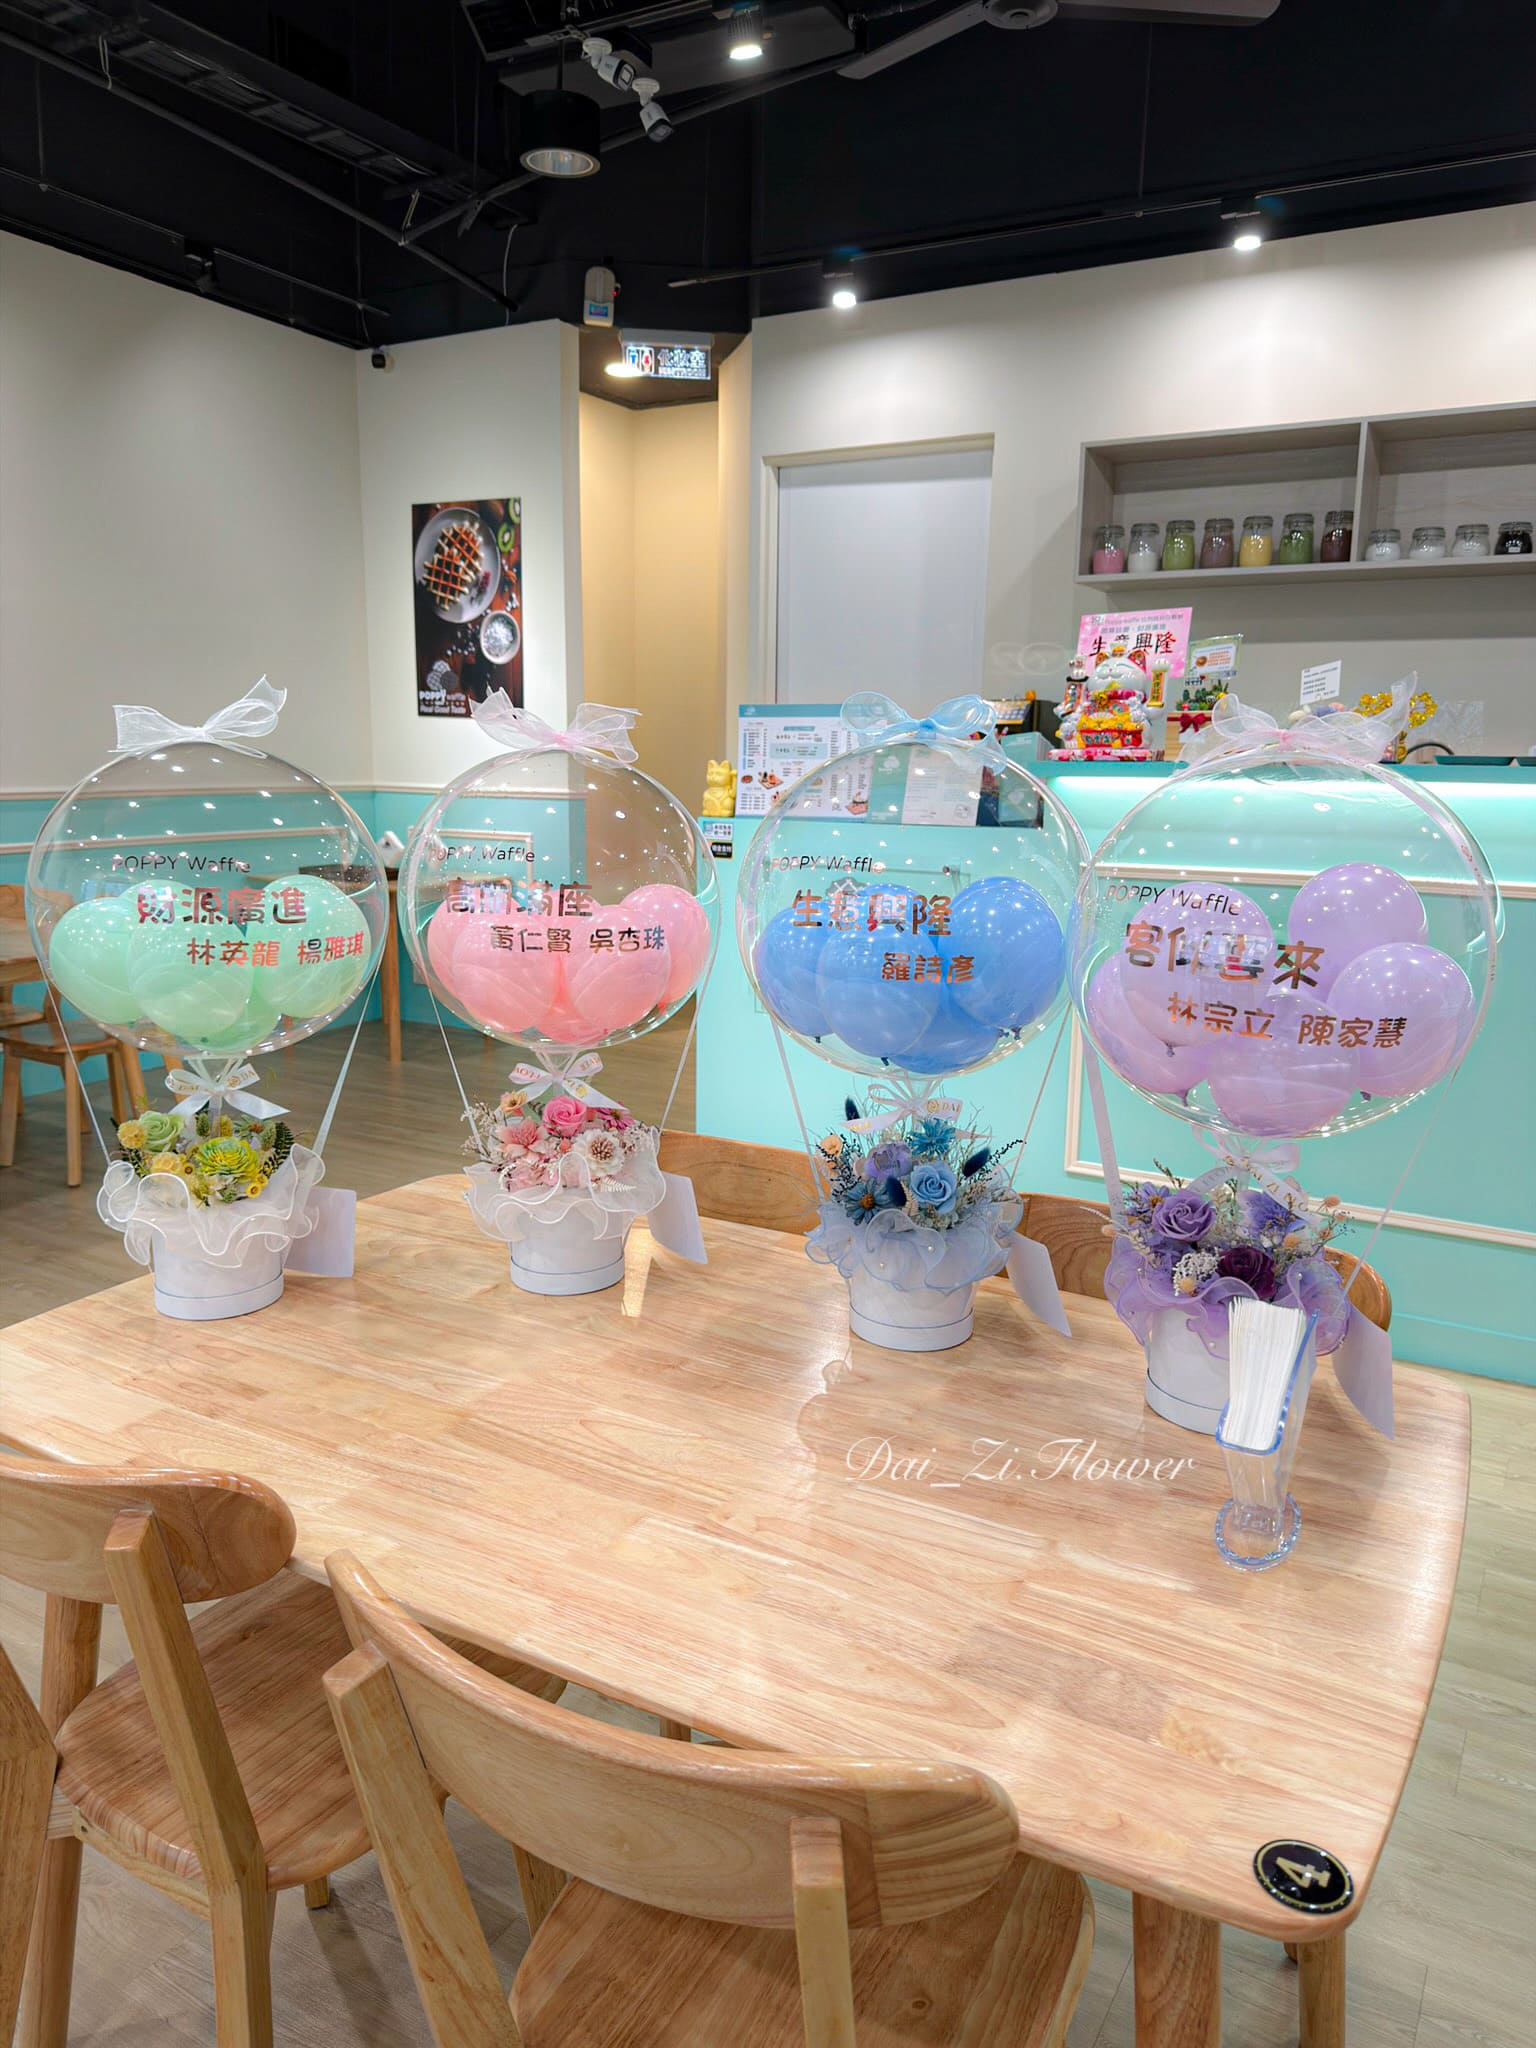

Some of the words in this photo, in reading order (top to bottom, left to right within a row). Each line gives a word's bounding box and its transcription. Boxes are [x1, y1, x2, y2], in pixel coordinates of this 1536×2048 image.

[112, 855, 180, 872] POPPY
[770, 855, 822, 872] POPPY
[137, 886, 307, 925] 財源廣進
[791, 889, 953, 936] 生意興隆
[1105, 885, 1166, 904] POPPY
[1172, 889, 1242, 916] Waffle
[187, 937, 281, 967] 林英龍
[297, 930, 365, 965] 楊雅琪
[589, 926, 666, 953] 吳杏珠
[1167, 992, 1275, 1040] 林宗立
[1298, 1014, 1408, 1049] 陳家慧
[1275, 1857, 1331, 1888] 4
